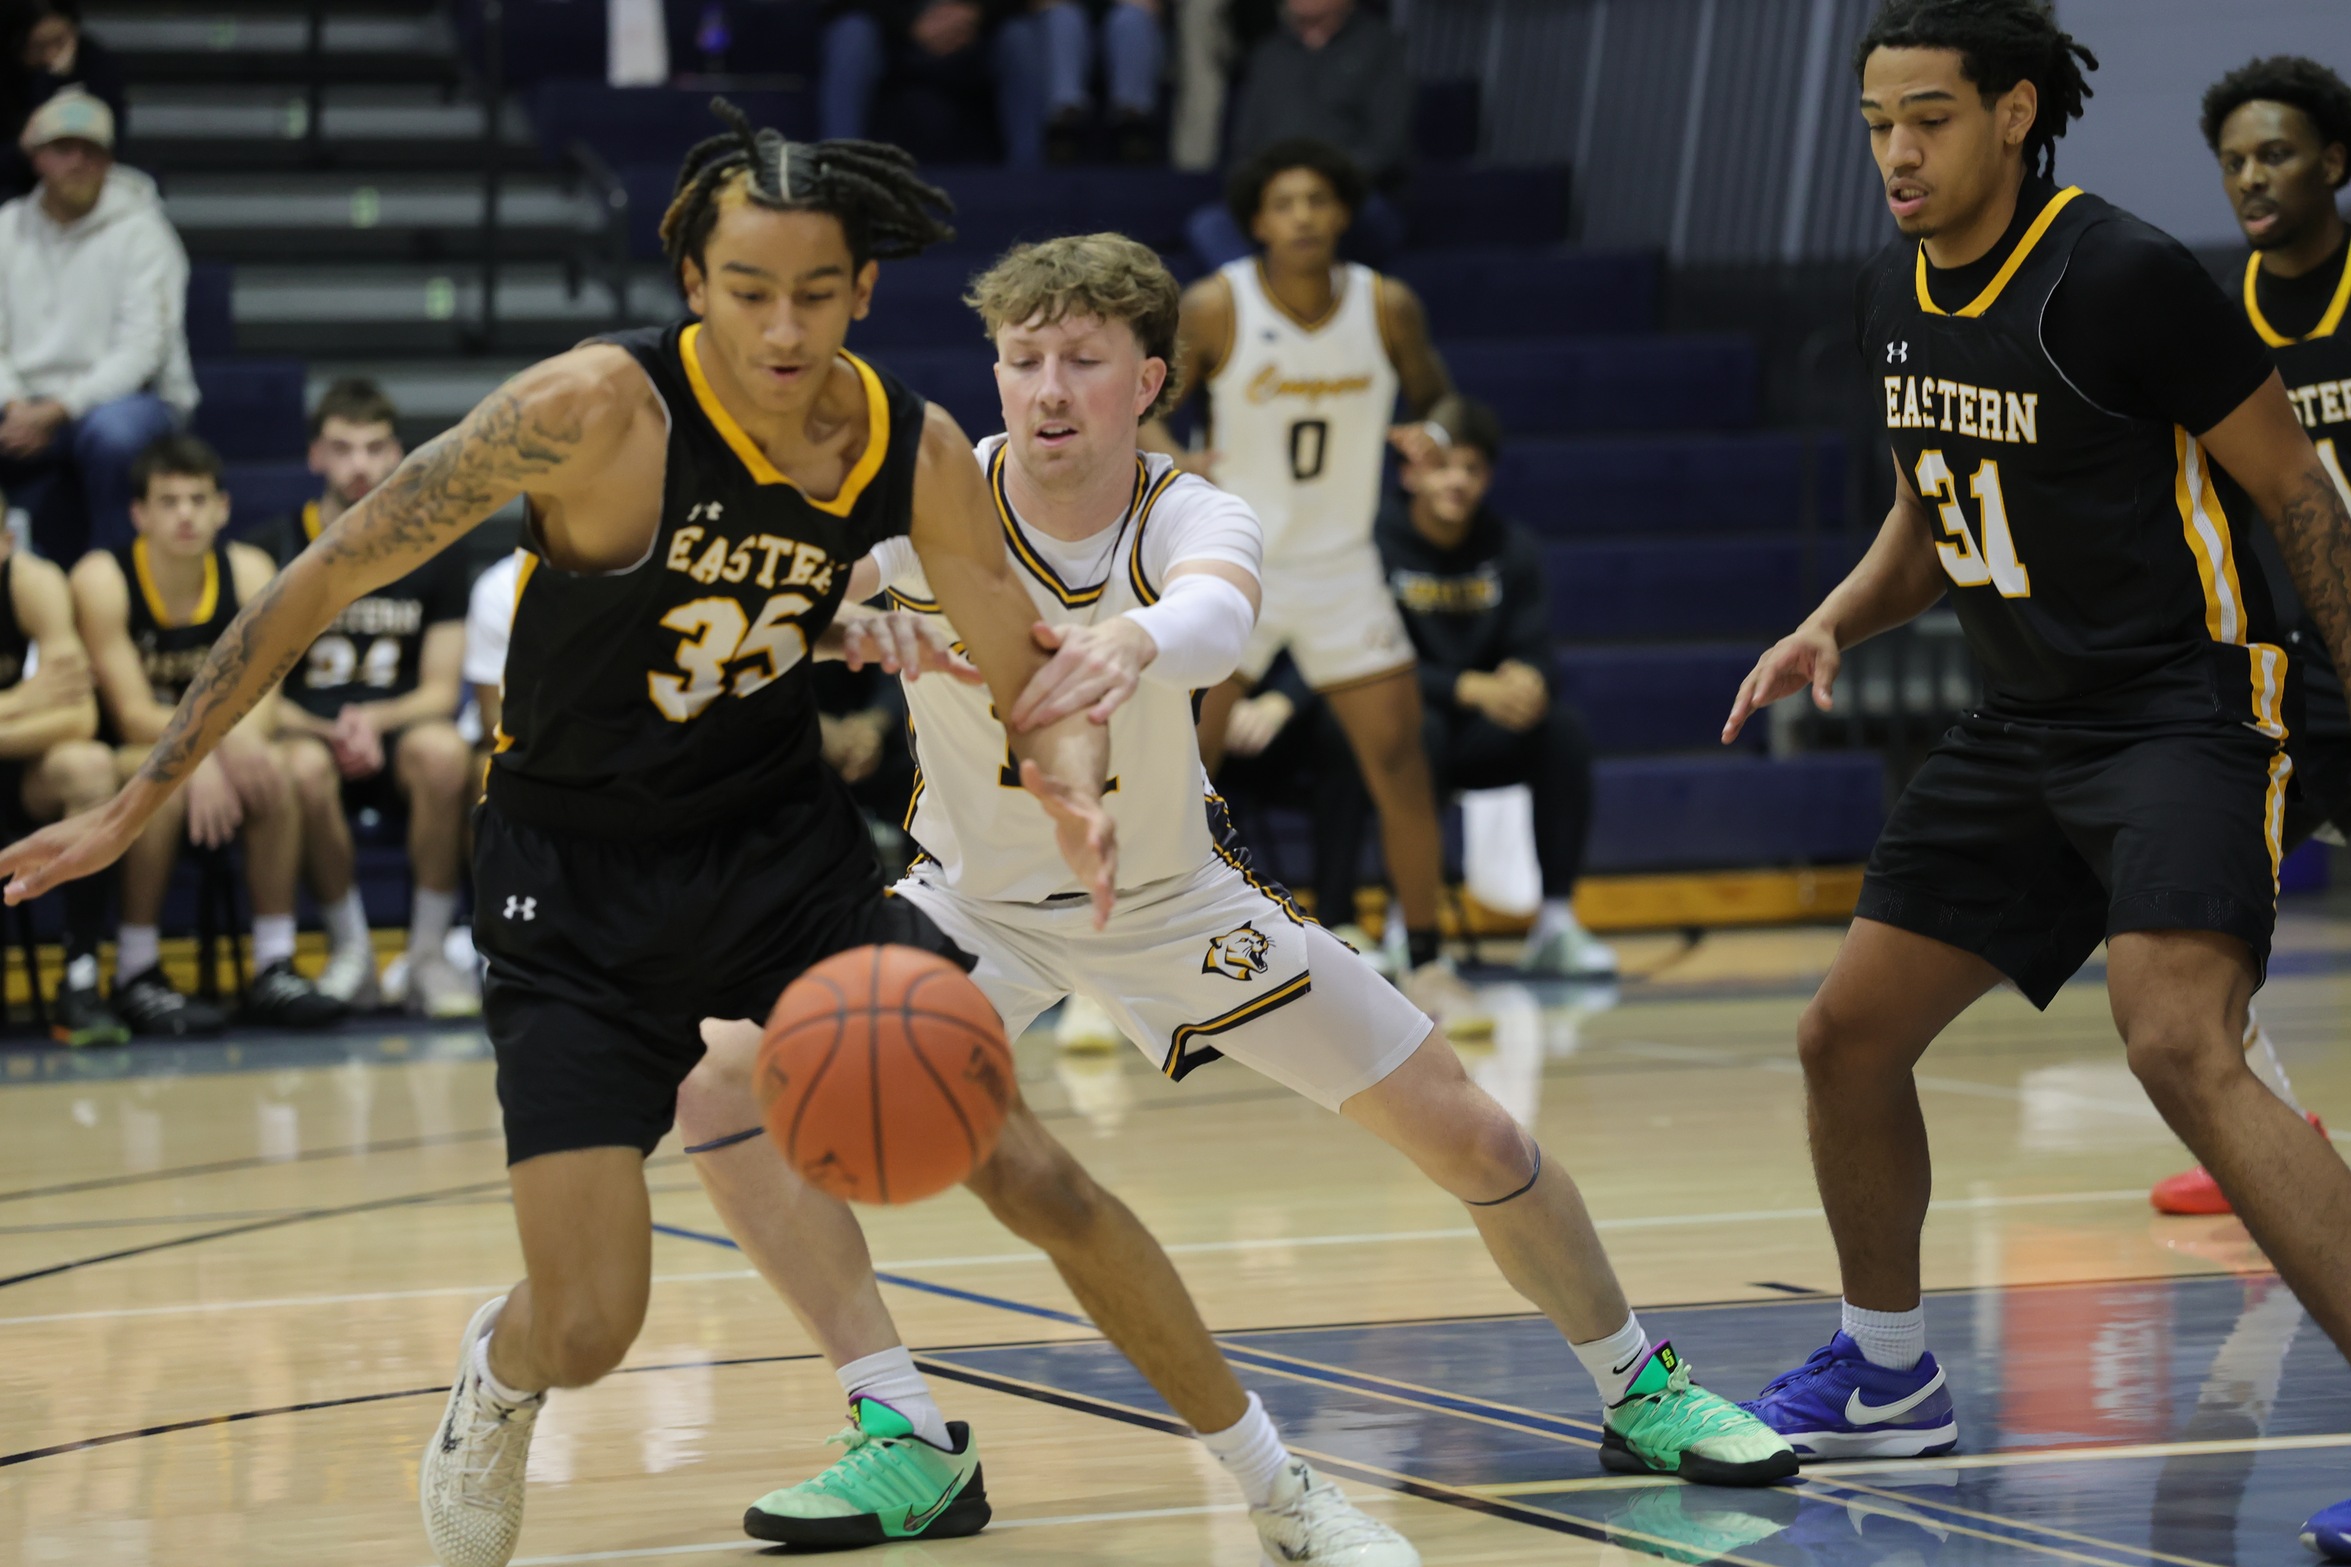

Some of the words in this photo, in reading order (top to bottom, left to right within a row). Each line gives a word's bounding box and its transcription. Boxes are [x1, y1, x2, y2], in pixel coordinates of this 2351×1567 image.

[1288, 419, 1329, 481] 0
[1884, 375, 2038, 444] EASTERN
[1915, 449, 2031, 598] 31
[647, 592, 814, 723] 35
